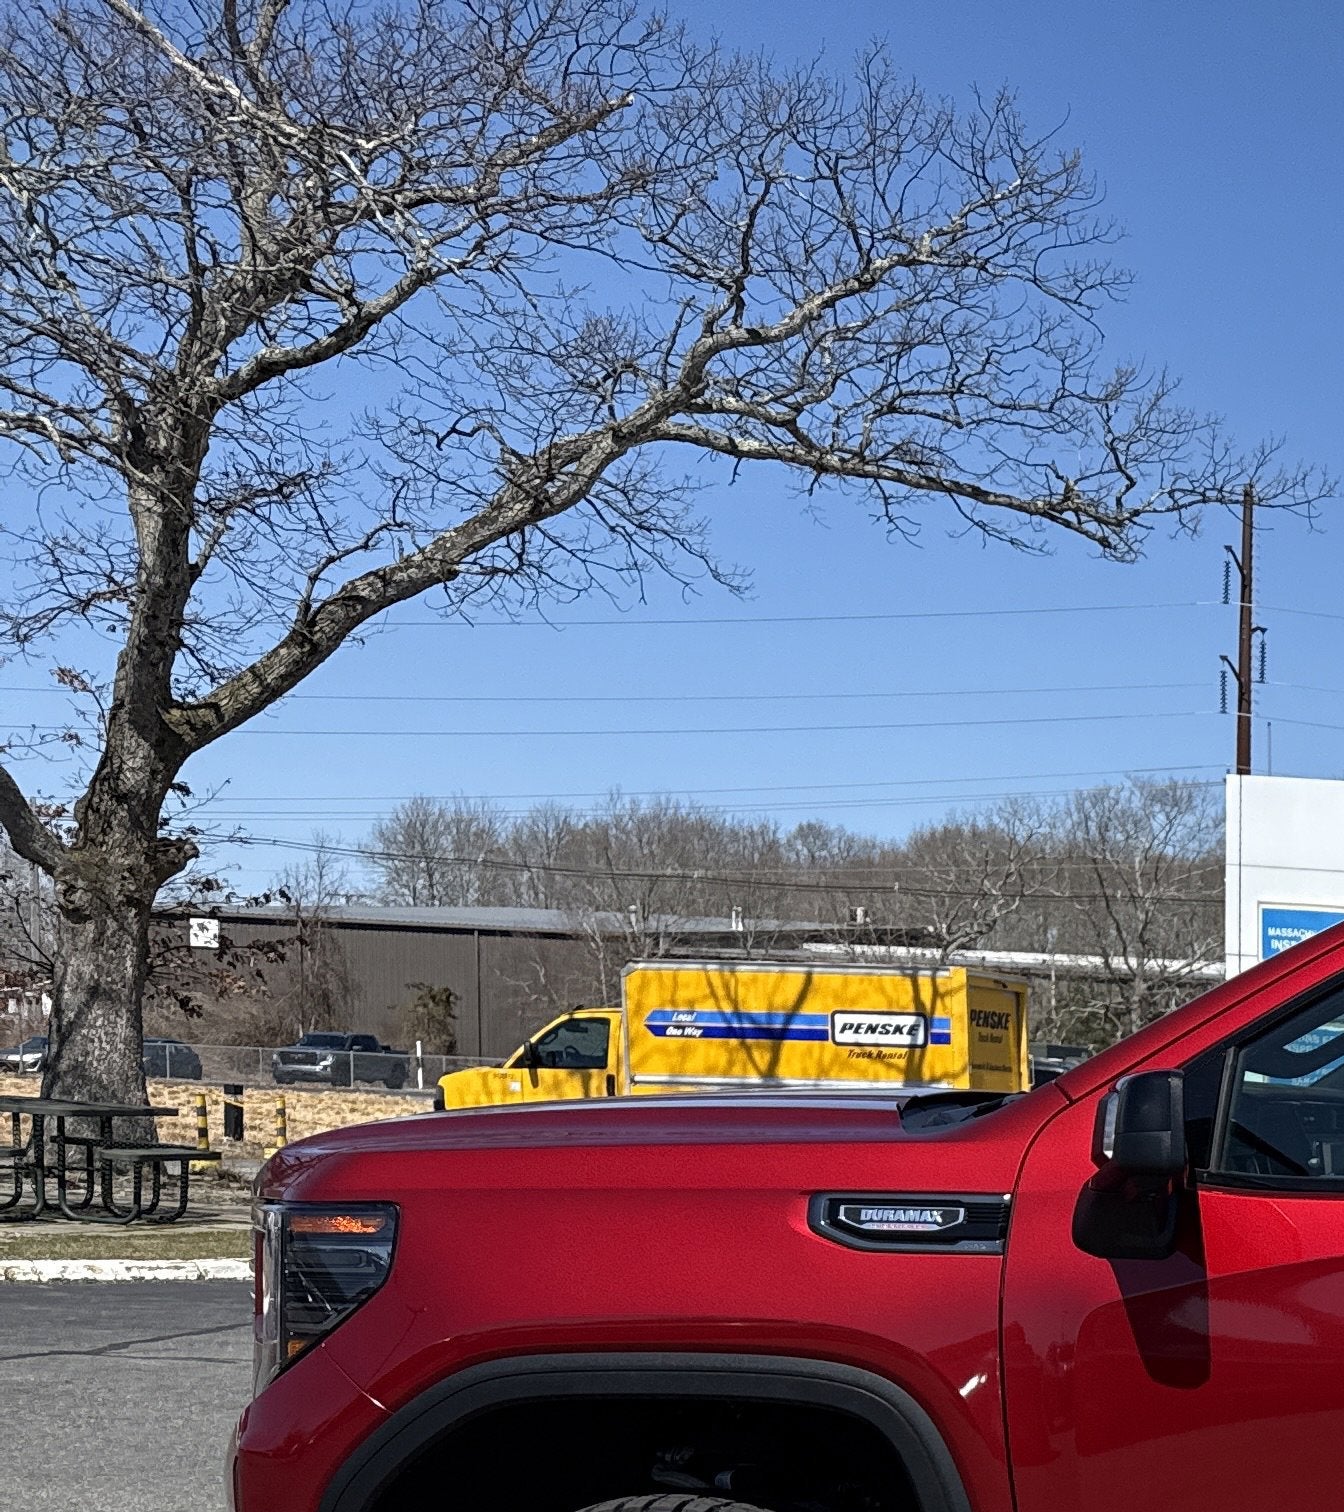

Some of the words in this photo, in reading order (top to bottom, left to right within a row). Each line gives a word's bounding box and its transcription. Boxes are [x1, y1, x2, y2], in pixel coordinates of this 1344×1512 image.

[671, 1012, 697, 1022] Local
[970, 1009, 1012, 1031] PENSKE
[683, 1027, 704, 1038] Way
[839, 1022, 921, 1037] PENSKE
[847, 1049, 873, 1059] Truck
[875, 1050, 908, 1060] Rental
[860, 1208, 943, 1223] DURAMAX
